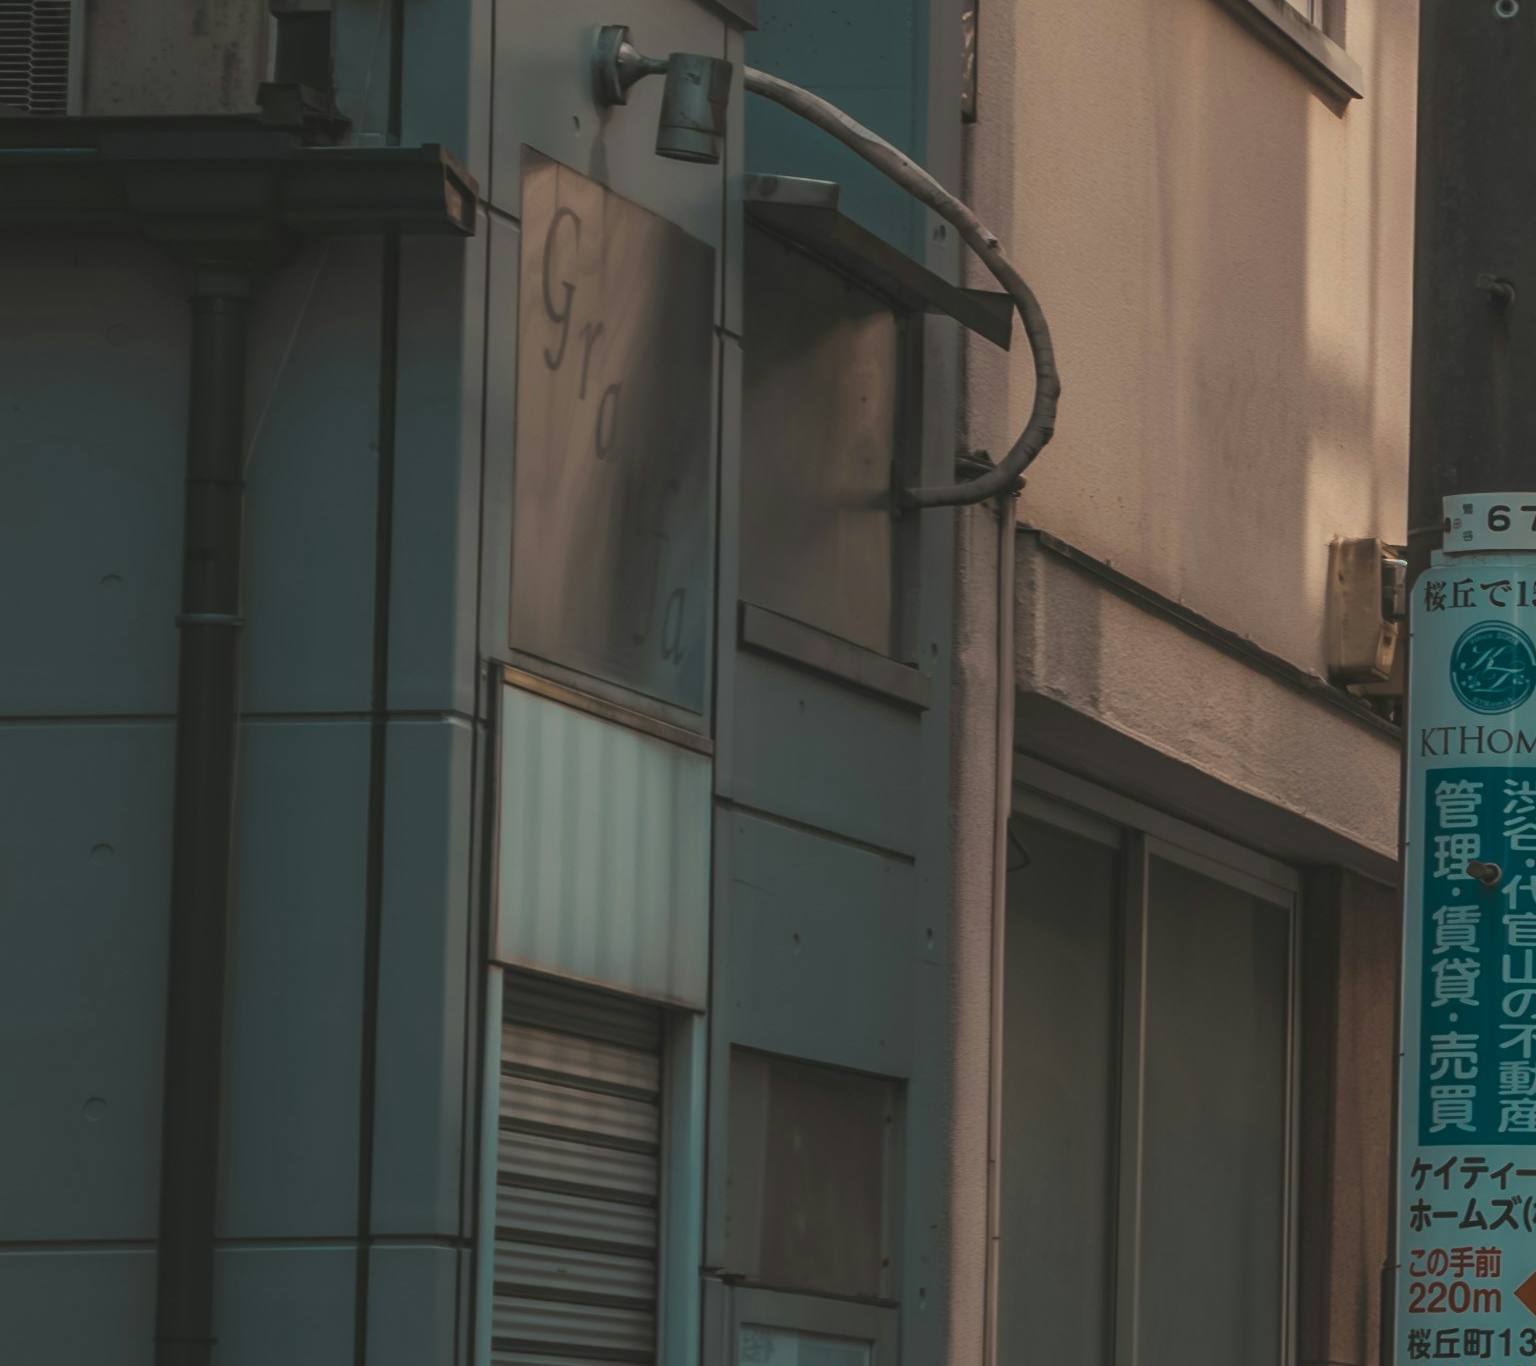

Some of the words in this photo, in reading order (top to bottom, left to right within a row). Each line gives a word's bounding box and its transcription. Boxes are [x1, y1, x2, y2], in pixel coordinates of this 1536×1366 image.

[1429, 778, 1484, 1133] 管理・賃貸・売買
[1409, 1246, 1502, 1279] この手前
[1408, 1281, 1502, 1315] 220m
